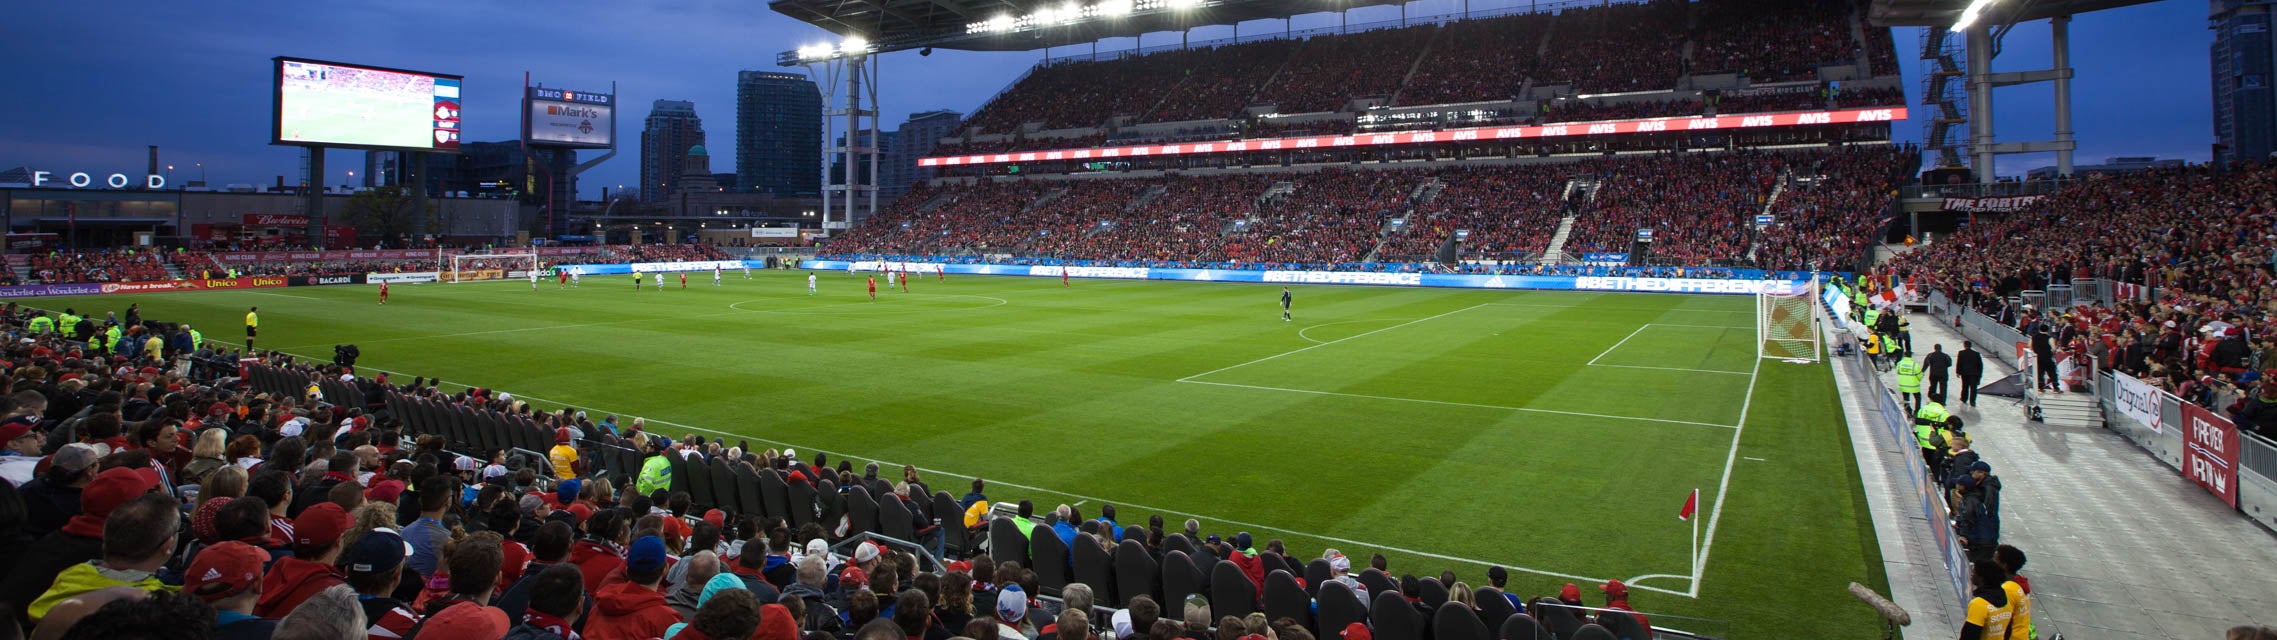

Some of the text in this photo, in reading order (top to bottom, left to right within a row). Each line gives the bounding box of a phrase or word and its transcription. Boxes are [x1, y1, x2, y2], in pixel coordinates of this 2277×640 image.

[537, 89, 608, 103] BMO FIELD
[558, 106, 598, 119] Mark's
[1020, 153, 1035, 161] AVIS
[1074, 150, 1090, 158] AVIS
[1131, 147, 1148, 155] AVIS
[1194, 144, 1212, 152] AVIS
[1227, 142, 1246, 150] AVIS
[1261, 140, 1281, 149] AVIS
[1296, 139, 1317, 147] AVIS
[1333, 136, 1354, 145] AVIS
[1372, 134, 1394, 144] AVIS
[1412, 132, 1435, 142] AVIS
[1453, 130, 1477, 140] AVIS
[1496, 128, 1521, 138] AVIS
[1541, 126, 1567, 136] AVIS
[1588, 123, 1615, 133] AVIS
[1637, 121, 1665, 131] AVIS
[1688, 118, 1718, 129] AVIS
[1741, 115, 1772, 126] AVIS
[1797, 112, 1830, 124] AVIS
[1857, 109, 1891, 121] AVIS
[34, 171, 165, 188] FOOD
[1944, 198, 1977, 210] THE
[207, 279, 237, 288] Unico
[253, 278, 282, 287] Unico
[1262, 270, 1422, 285] #BETHEDIFFERENCE
[1575, 276, 1792, 294] #BETHEDIFFERENCE
[0, 288, 46, 297] onderlist.ca
[2116, 380, 2149, 414] Original
[2193, 416, 2224, 454] FREVER
